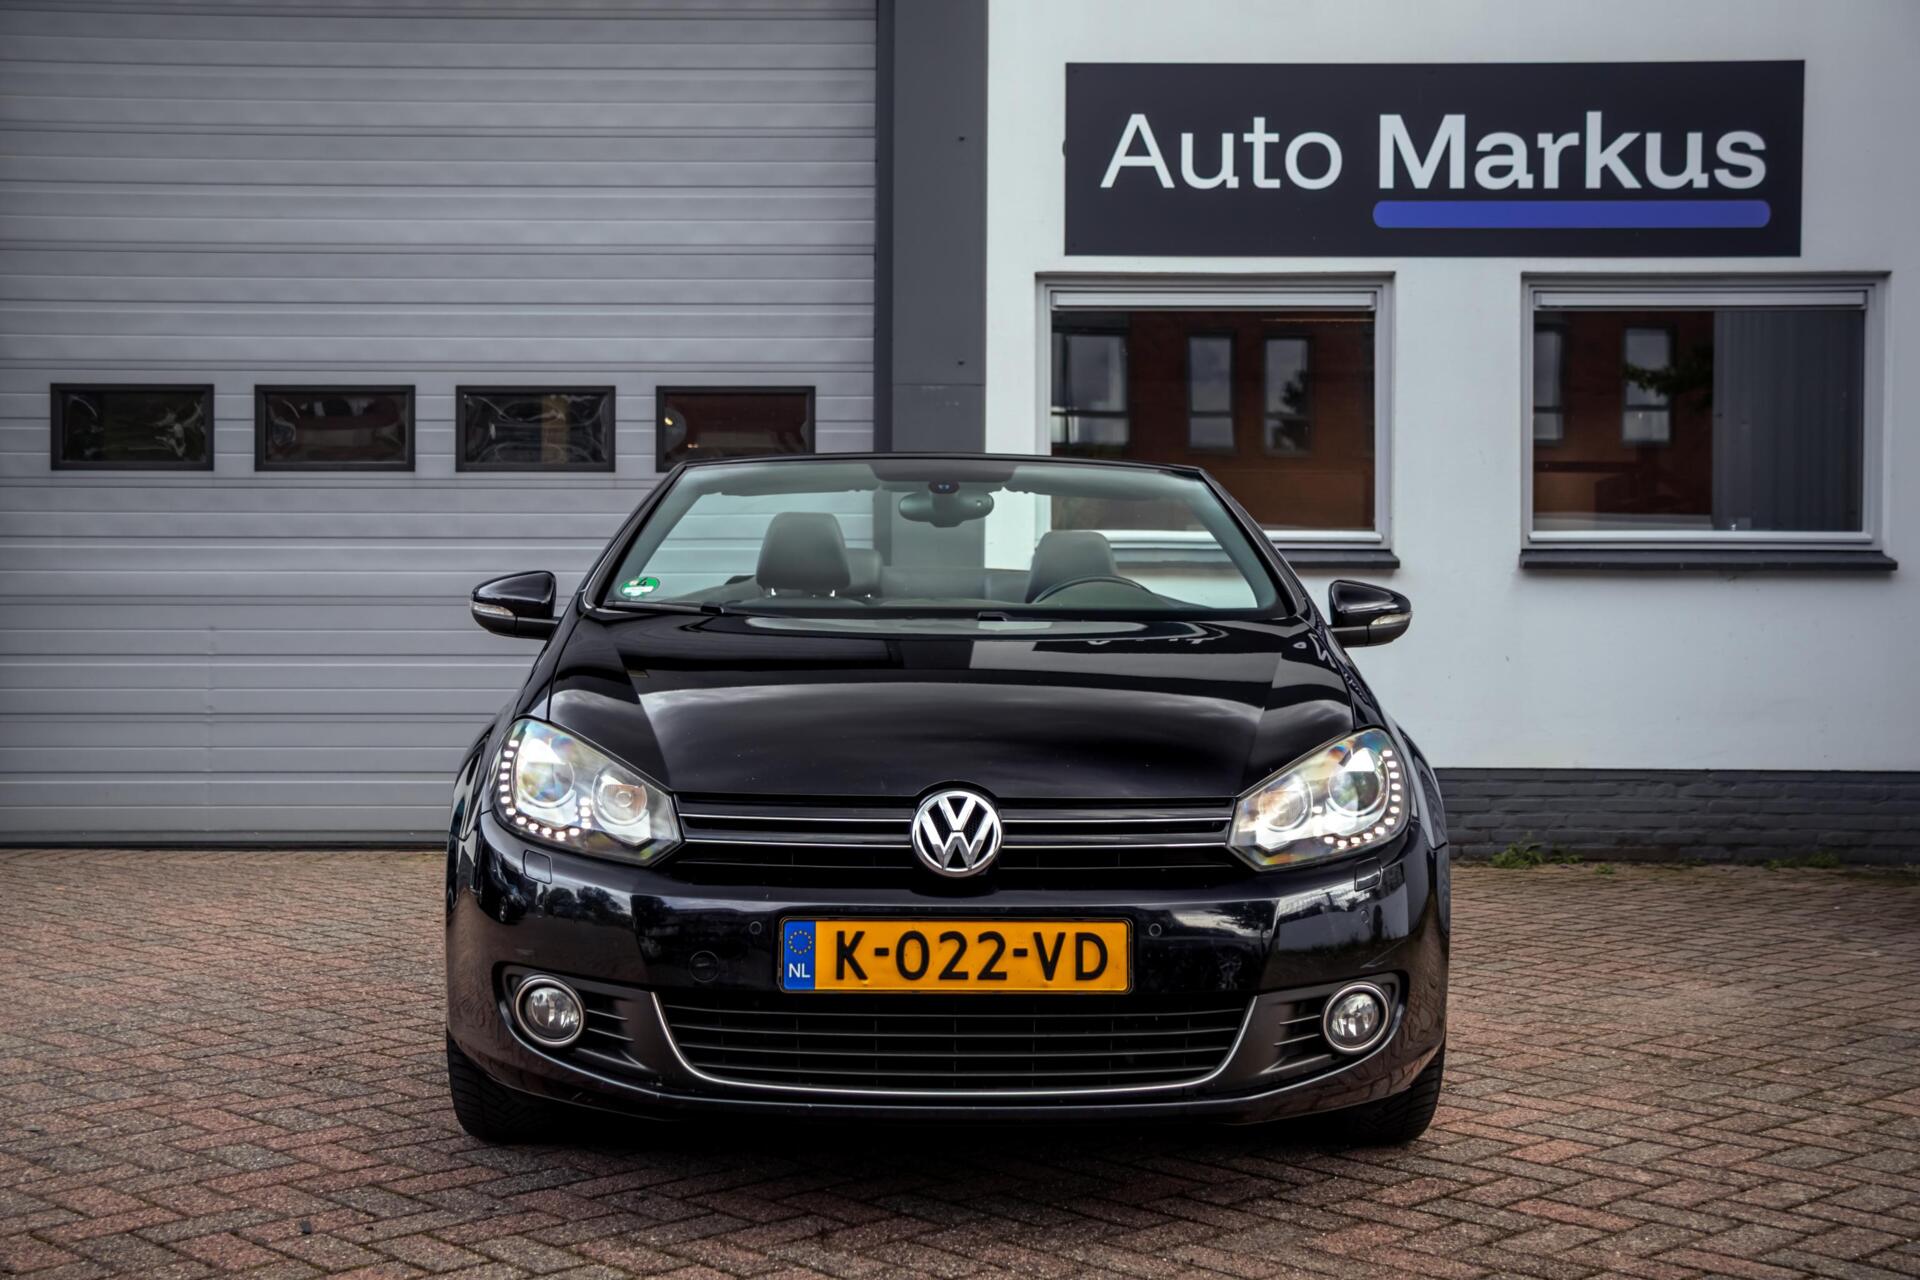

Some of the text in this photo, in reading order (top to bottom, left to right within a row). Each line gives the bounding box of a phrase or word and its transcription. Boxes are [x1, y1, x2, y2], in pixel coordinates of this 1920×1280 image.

[1100, 110, 1768, 190] Auto Markus
[917, 793, 997, 871] VW
[788, 962, 811, 978] NL
[835, 930, 1108, 982] K-022-VD
